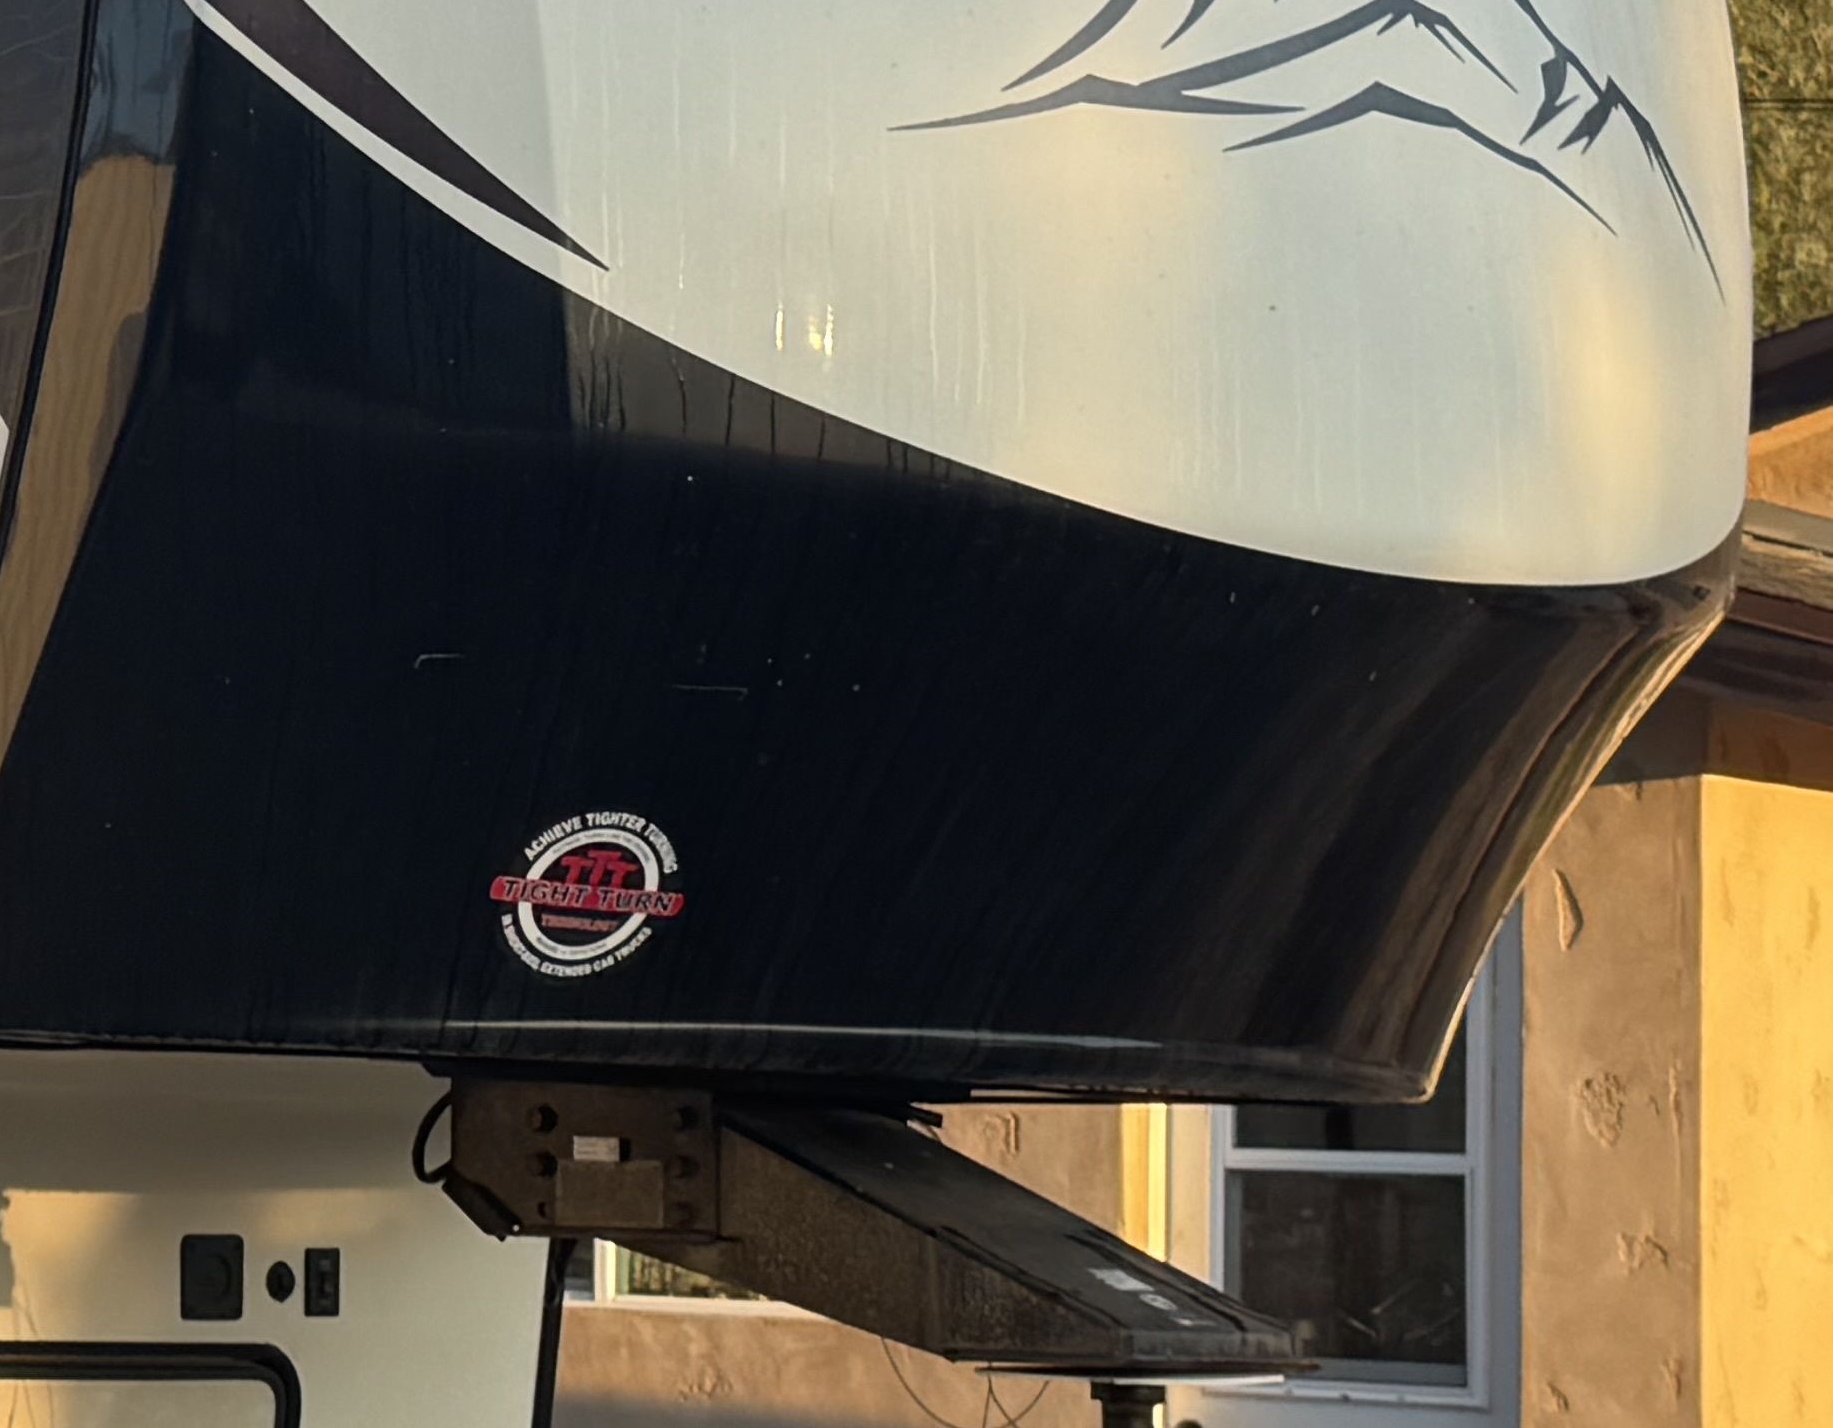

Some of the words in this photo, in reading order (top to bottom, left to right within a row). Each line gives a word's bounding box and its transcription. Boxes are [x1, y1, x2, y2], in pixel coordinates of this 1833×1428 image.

[524, 816, 583, 861] ACHIEVE
[586, 811, 646, 833] TIGHTER
[503, 880, 589, 905] TIGHT
[600, 888, 676, 913] TURN
